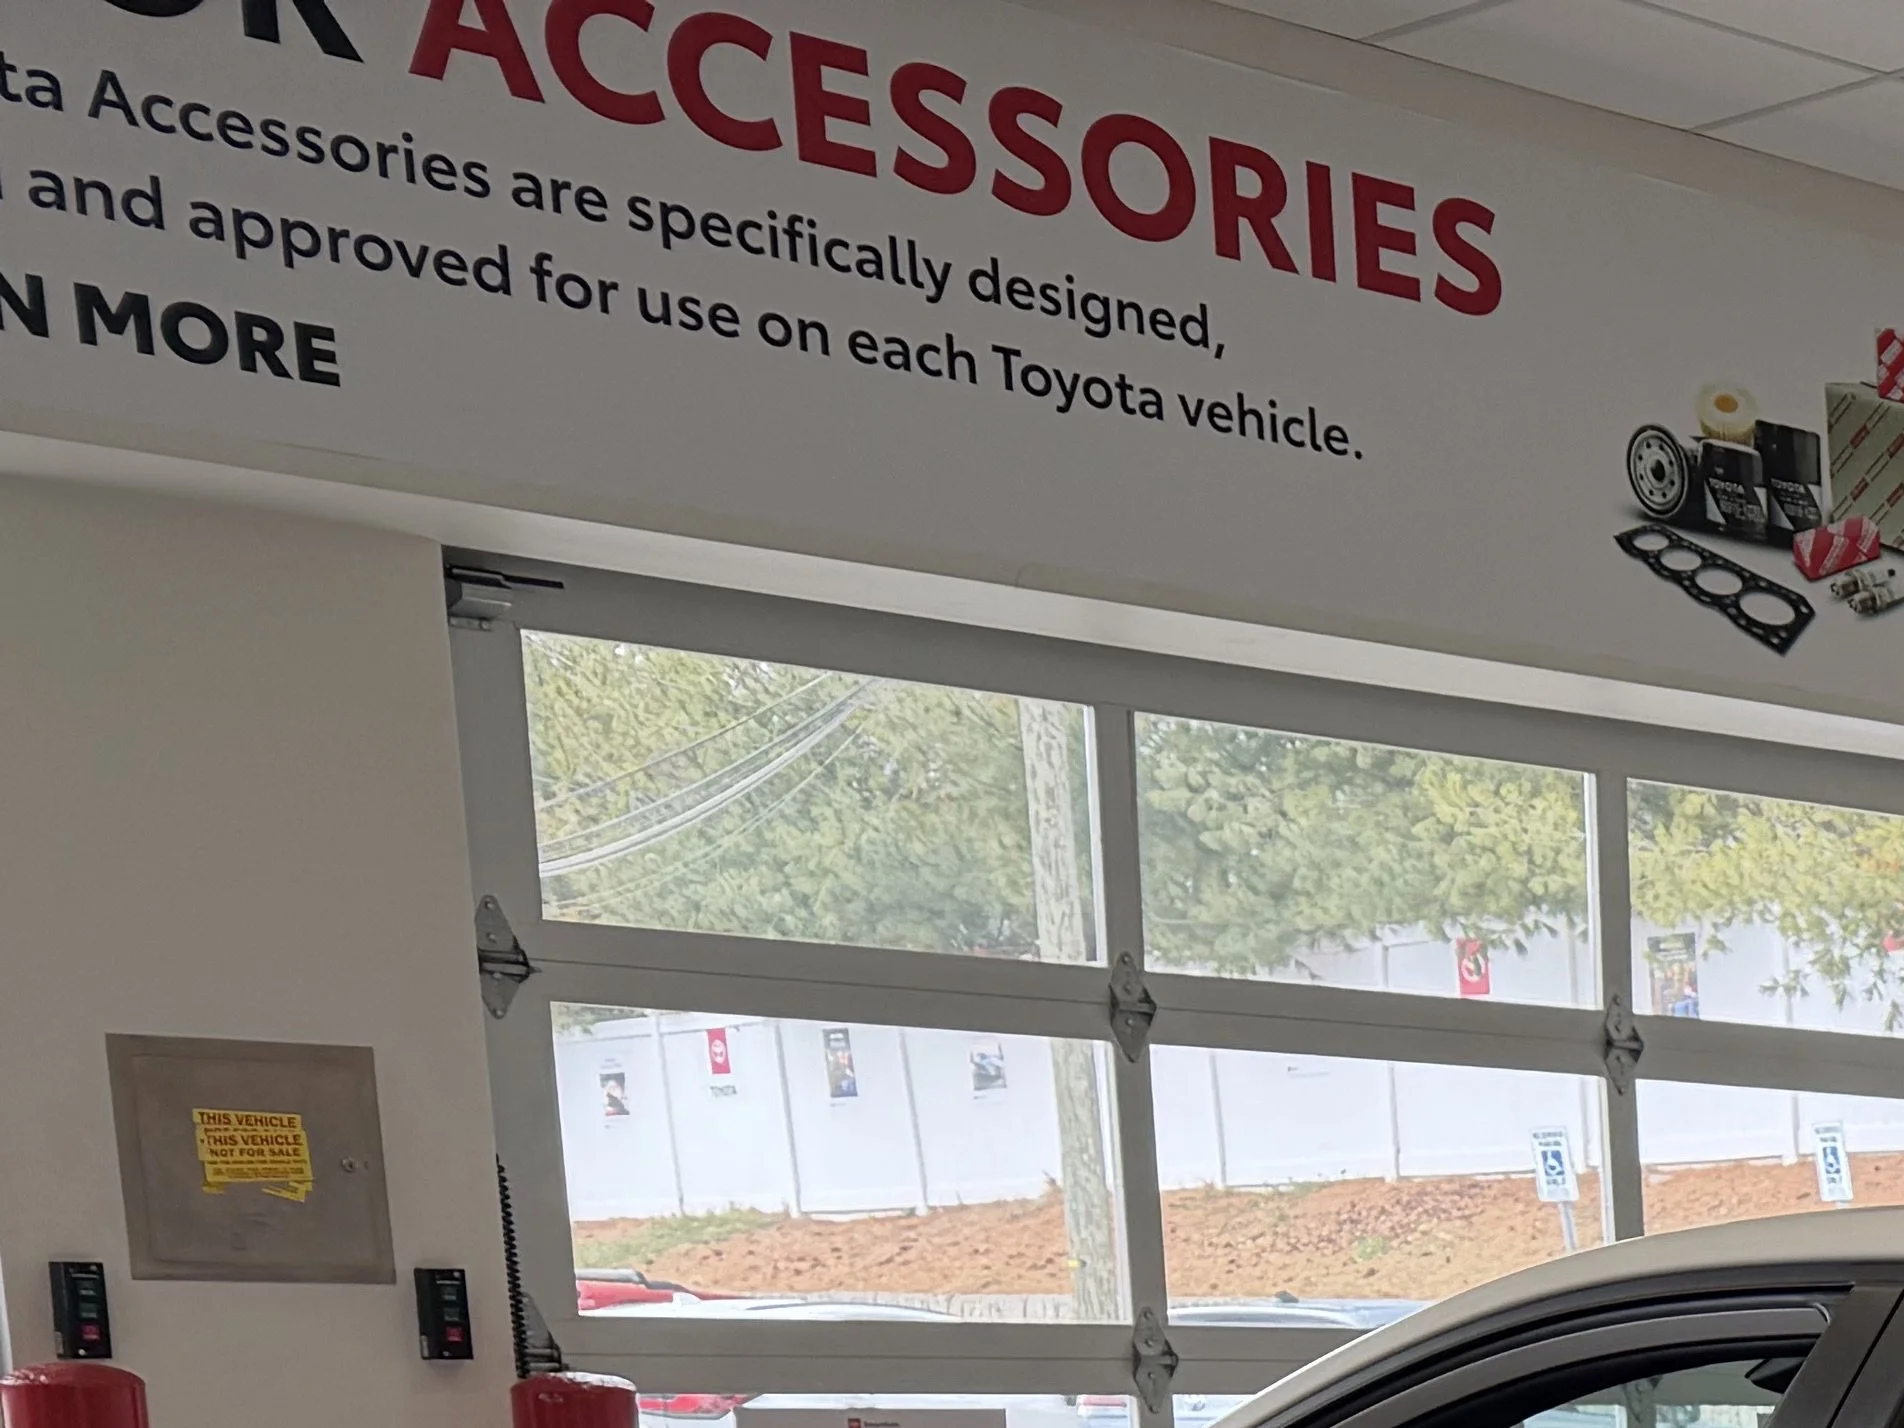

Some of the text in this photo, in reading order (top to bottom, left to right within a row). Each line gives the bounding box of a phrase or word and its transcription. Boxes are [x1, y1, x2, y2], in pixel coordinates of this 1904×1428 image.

[409, 0, 1502, 316] ACCESSORIES
[88, 69, 491, 199] Accessories
[511, 169, 608, 223] are
[627, 194, 953, 304] specifically
[967, 257, 1226, 359] designed,
[28, 168, 1364, 460] and approved for use on each Toyota vehicle.
[73, 281, 342, 388] MORE
[198, 1111, 297, 1128] THIS VEHICLE
[206, 1134, 303, 1146] THIS VEHICLE
[209, 1147, 300, 1157] NOT FOR SALE
